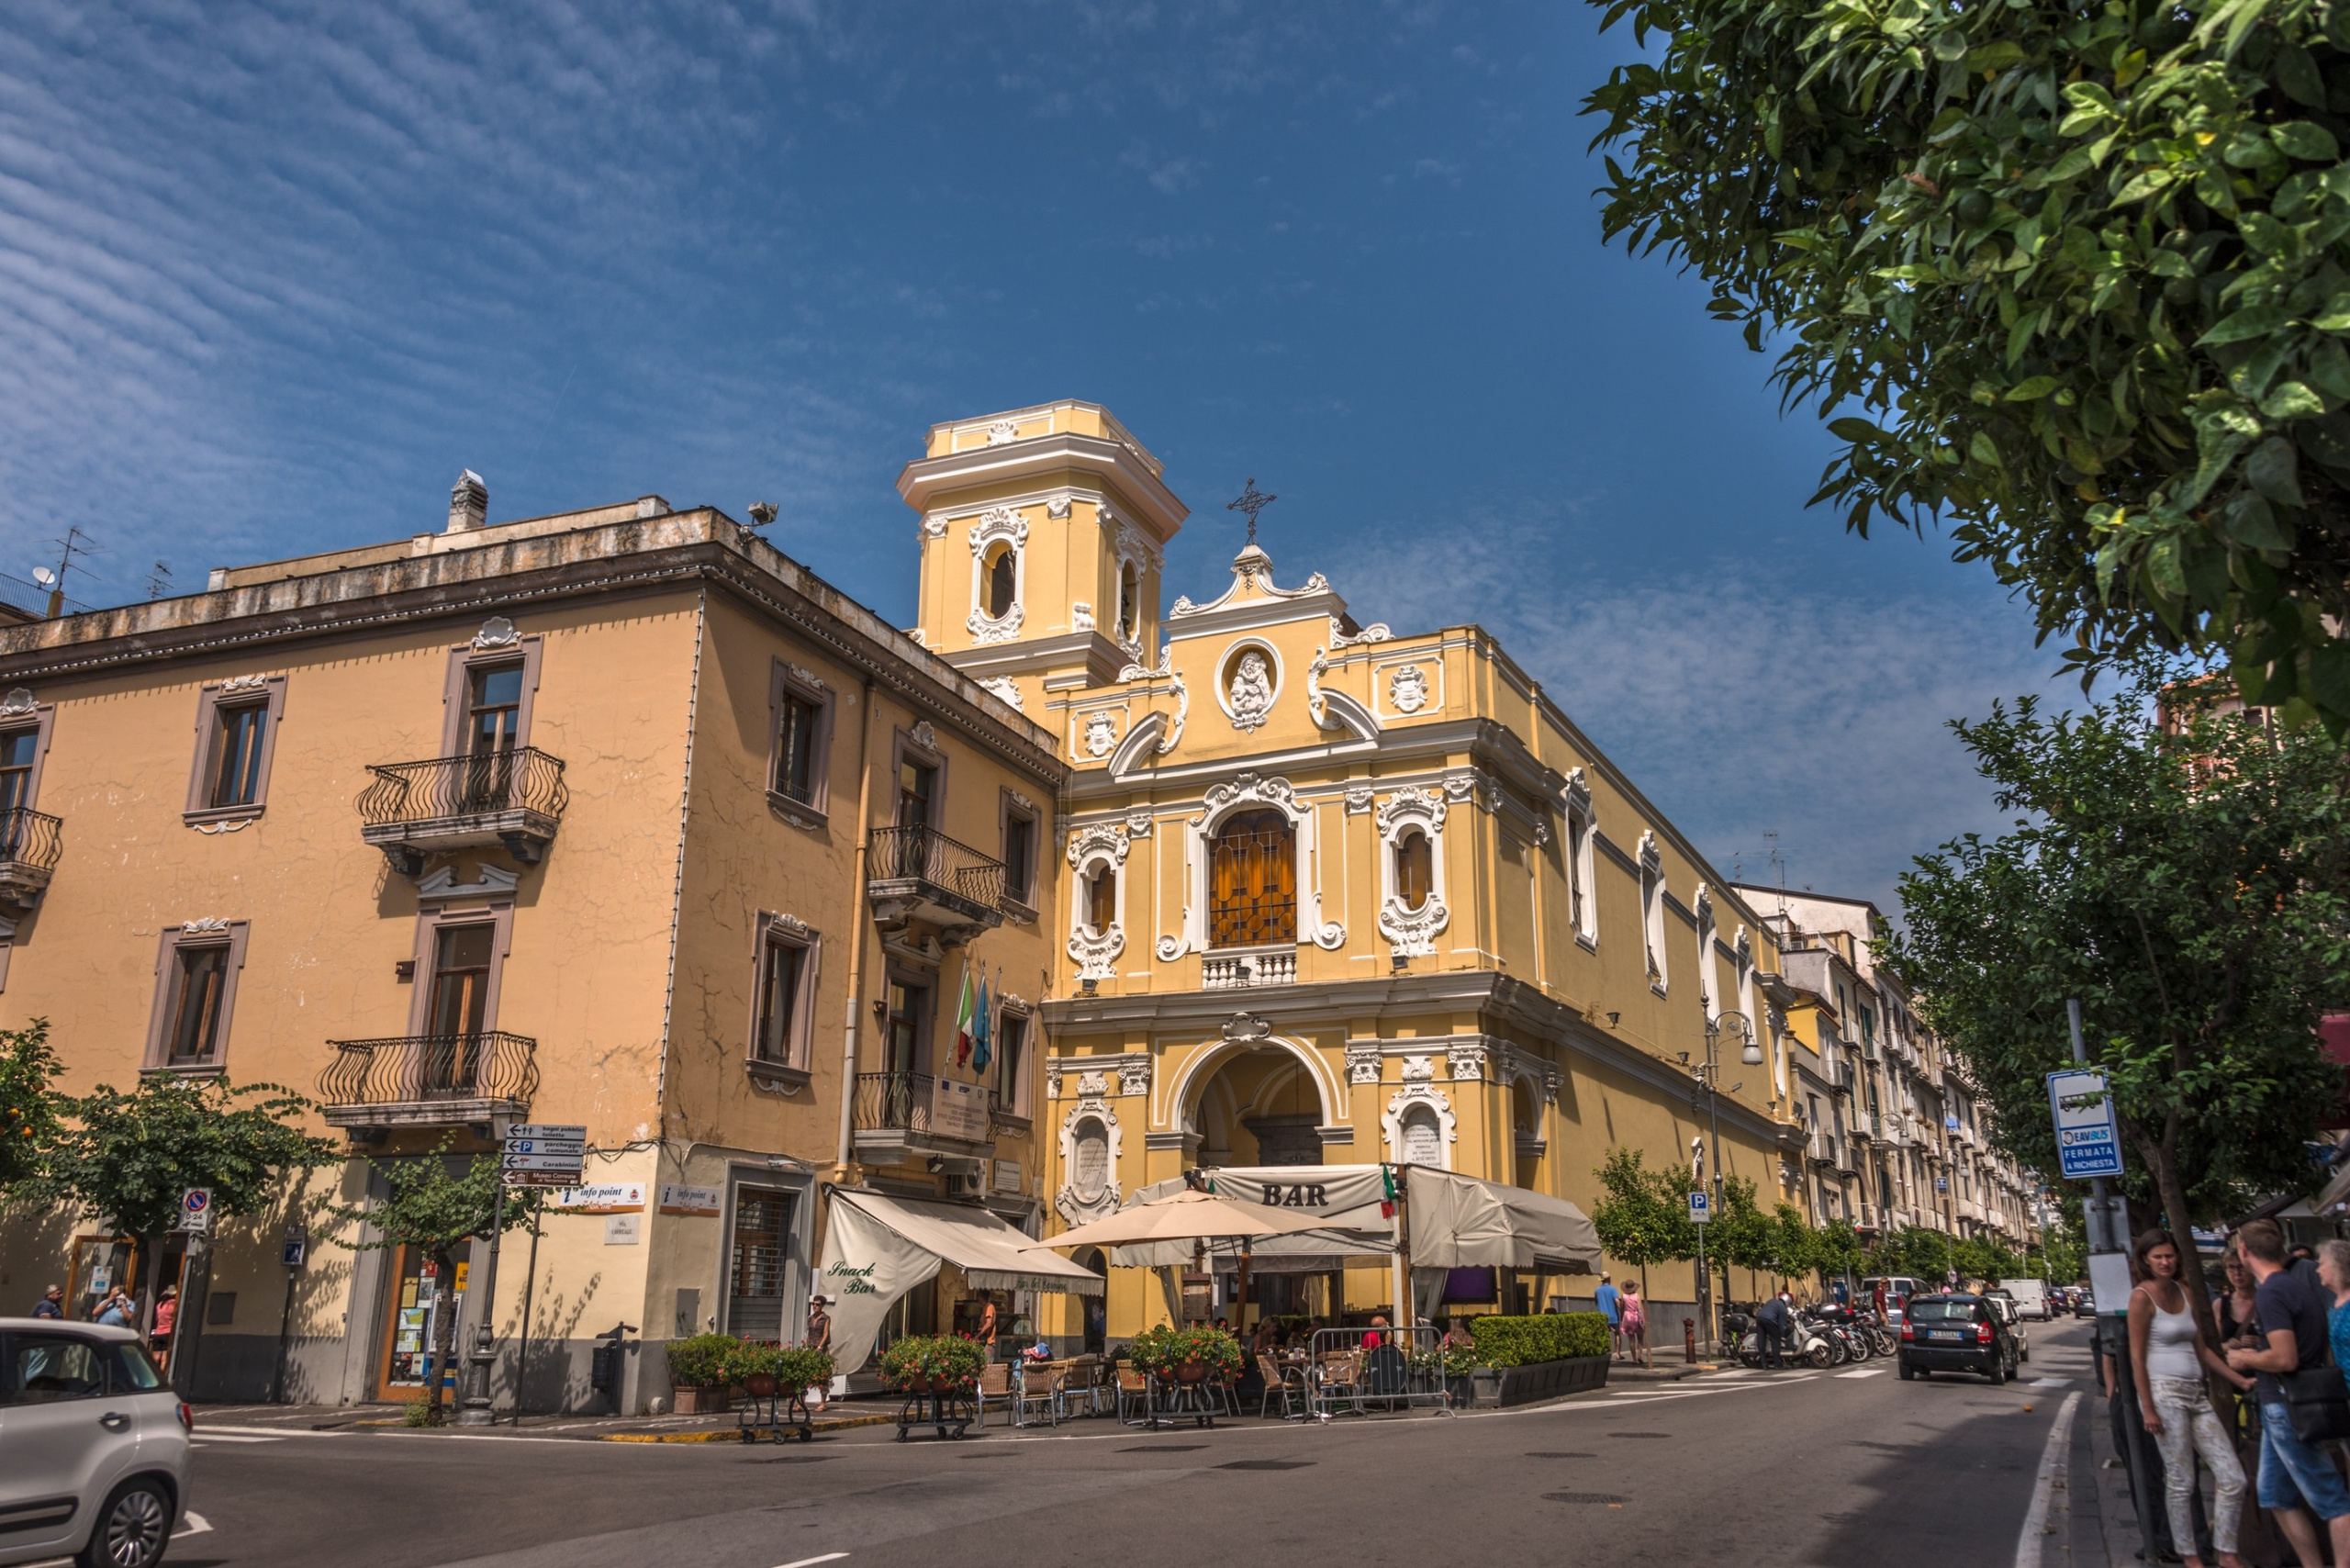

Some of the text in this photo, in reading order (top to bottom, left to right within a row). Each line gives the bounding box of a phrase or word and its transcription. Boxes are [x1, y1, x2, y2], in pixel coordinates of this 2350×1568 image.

[2075, 1129, 2109, 1142] EAVBUS
[2065, 1147, 2113, 1159] FERMATA
[2066, 1159, 2115, 1170] A RICHIESTA
[580, 1187, 598, 1199] info
[598, 1187, 622, 1198] point
[677, 1188, 689, 1200] info
[688, 1190, 707, 1201] point
[1261, 1184, 1329, 1207] BAR
[1695, 1195, 1705, 1208] P
[827, 1260, 877, 1277] Snack
[844, 1278, 877, 1294] Bar
